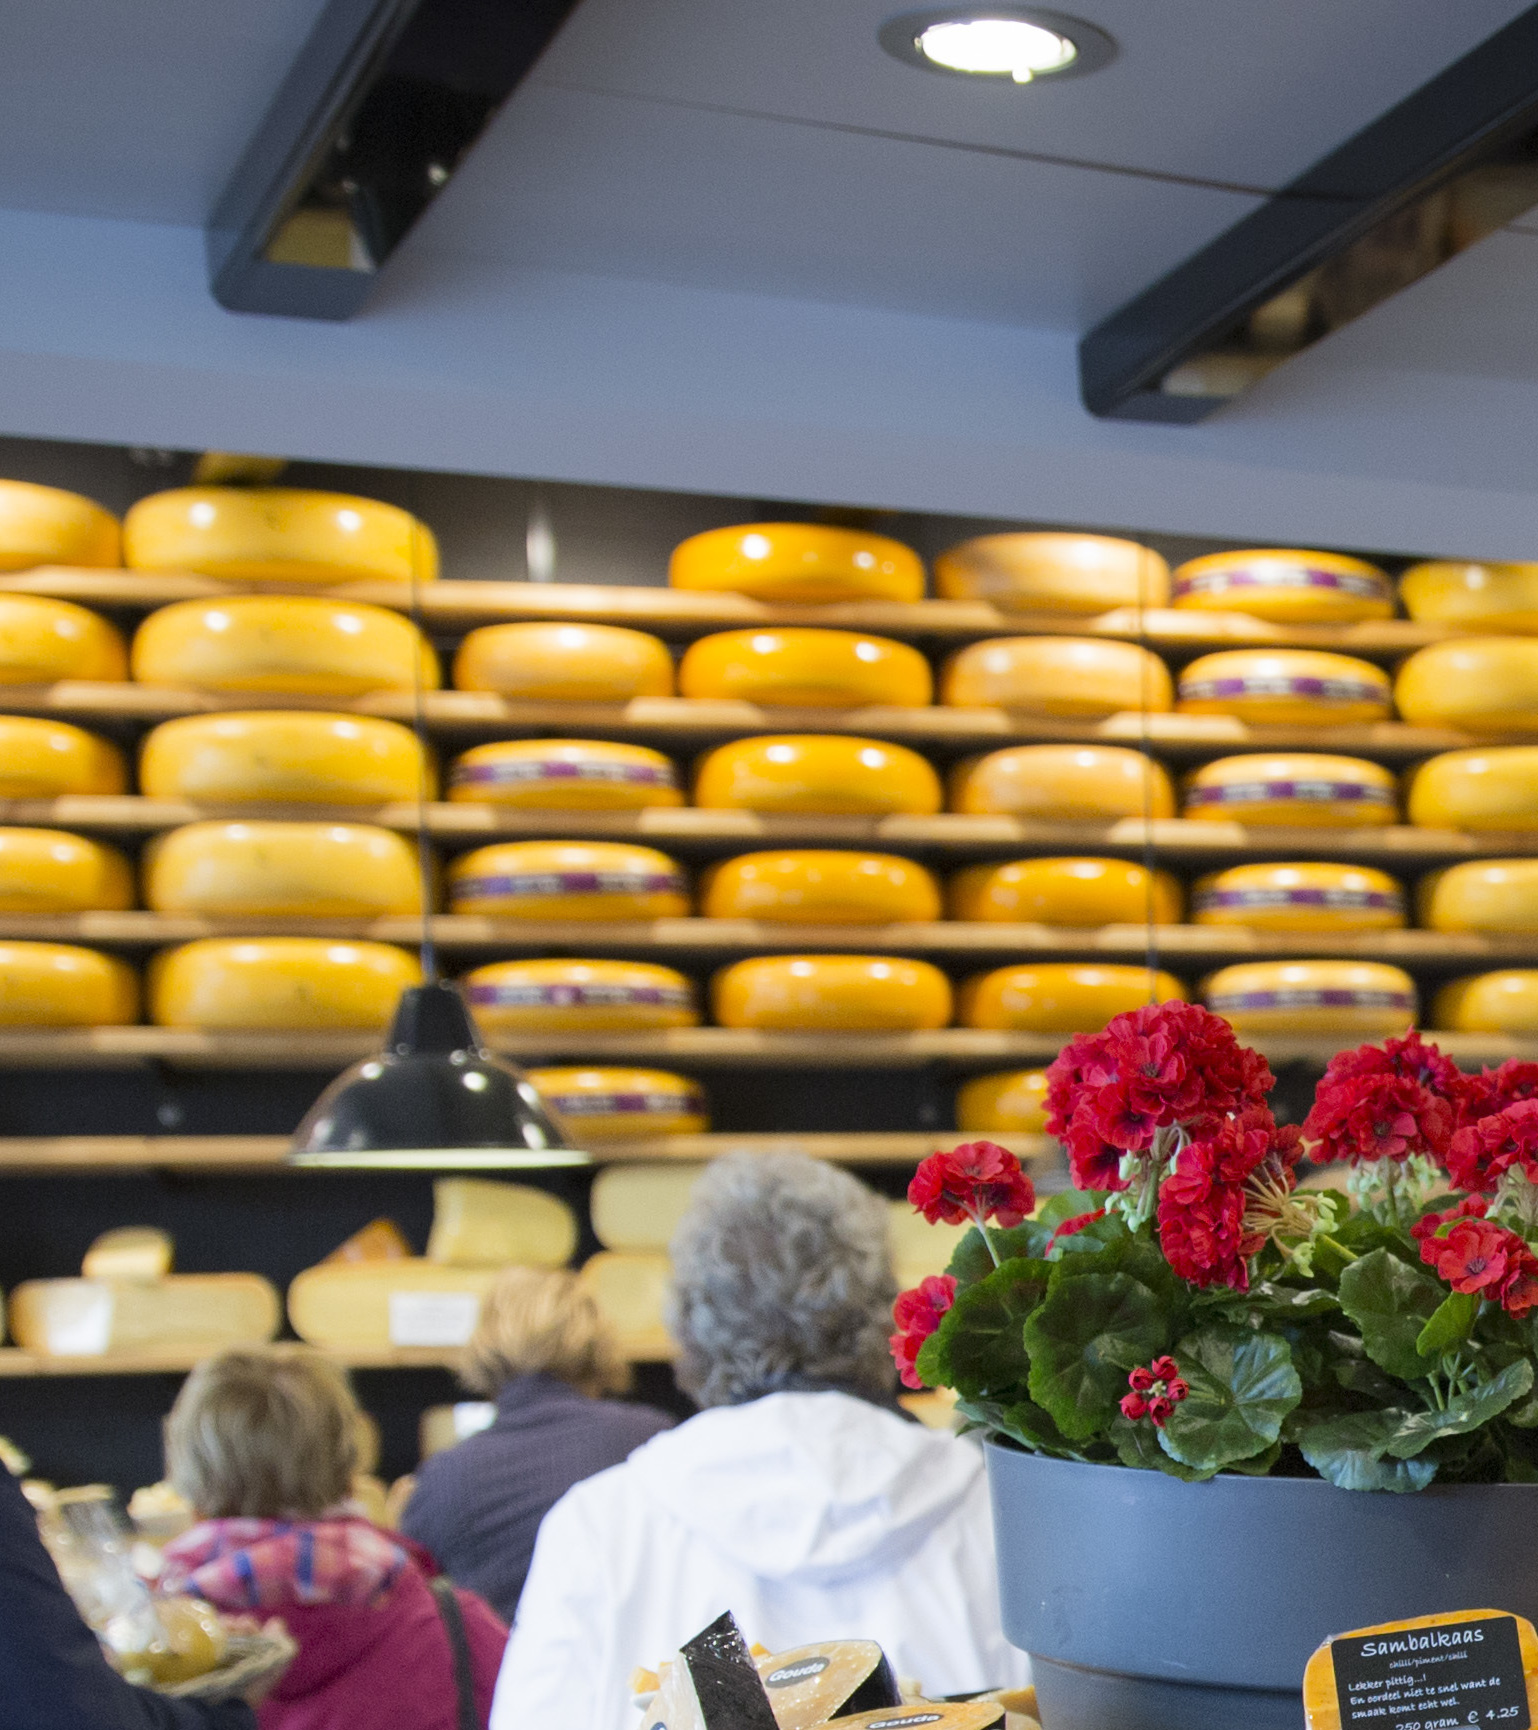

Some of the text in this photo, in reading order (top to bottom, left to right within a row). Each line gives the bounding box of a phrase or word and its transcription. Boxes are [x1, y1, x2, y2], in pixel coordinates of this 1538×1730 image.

[1361, 1628, 1484, 1657] Sambalkaas
[768, 1661, 826, 1682] Gouda
[1349, 1677, 1382, 1691] Lekker
[1350, 1676, 1501, 1706] En oordeel niet te snel want de
[1352, 1697, 1460, 1719] smaak komt echt wel.
[1467, 1711, 1479, 1723] €
[1485, 1706, 1520, 1721] 4.25
[869, 1714, 940, 1730] Gouda
